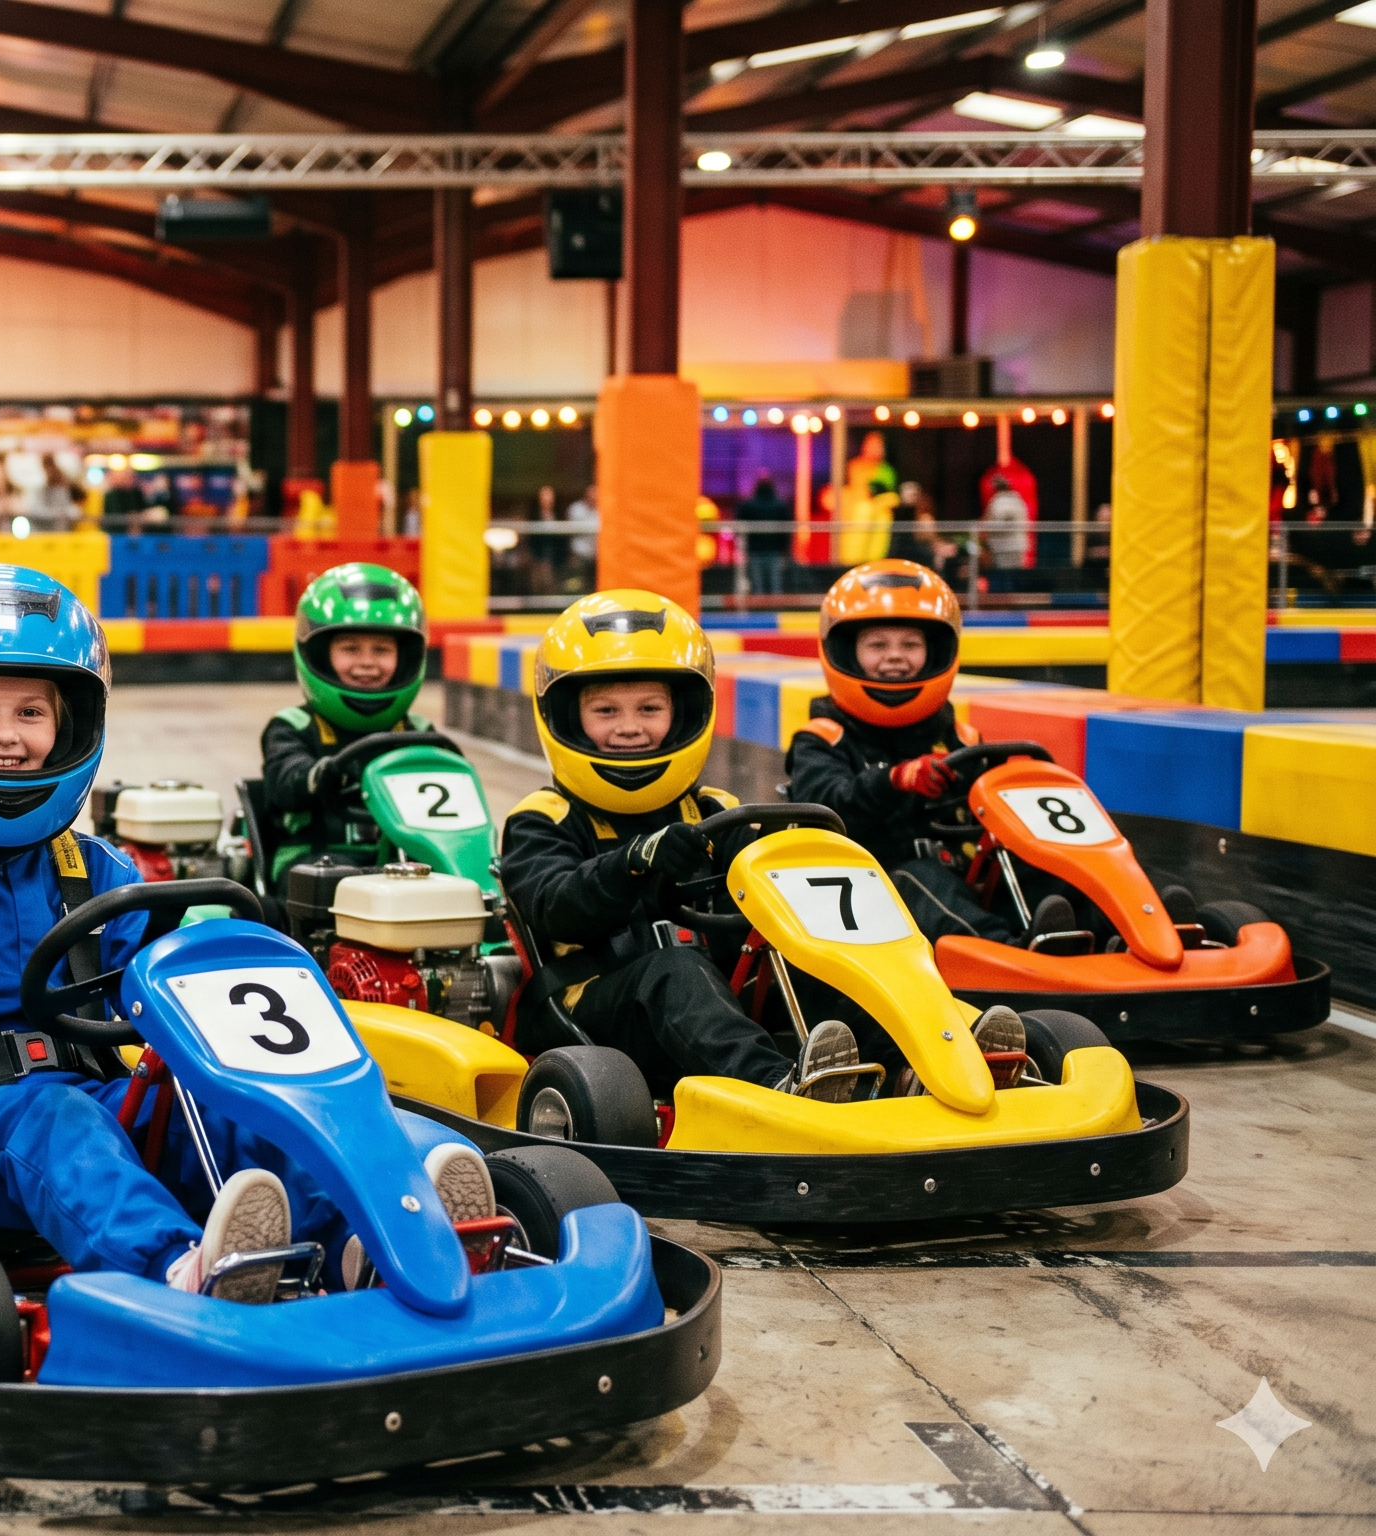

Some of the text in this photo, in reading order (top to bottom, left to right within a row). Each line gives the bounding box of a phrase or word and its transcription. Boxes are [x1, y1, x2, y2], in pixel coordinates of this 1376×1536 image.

[419, 783, 458, 817] 2
[1038, 797, 1085, 834] 8
[806, 877, 858, 930] 7
[229, 983, 309, 1054] 3
